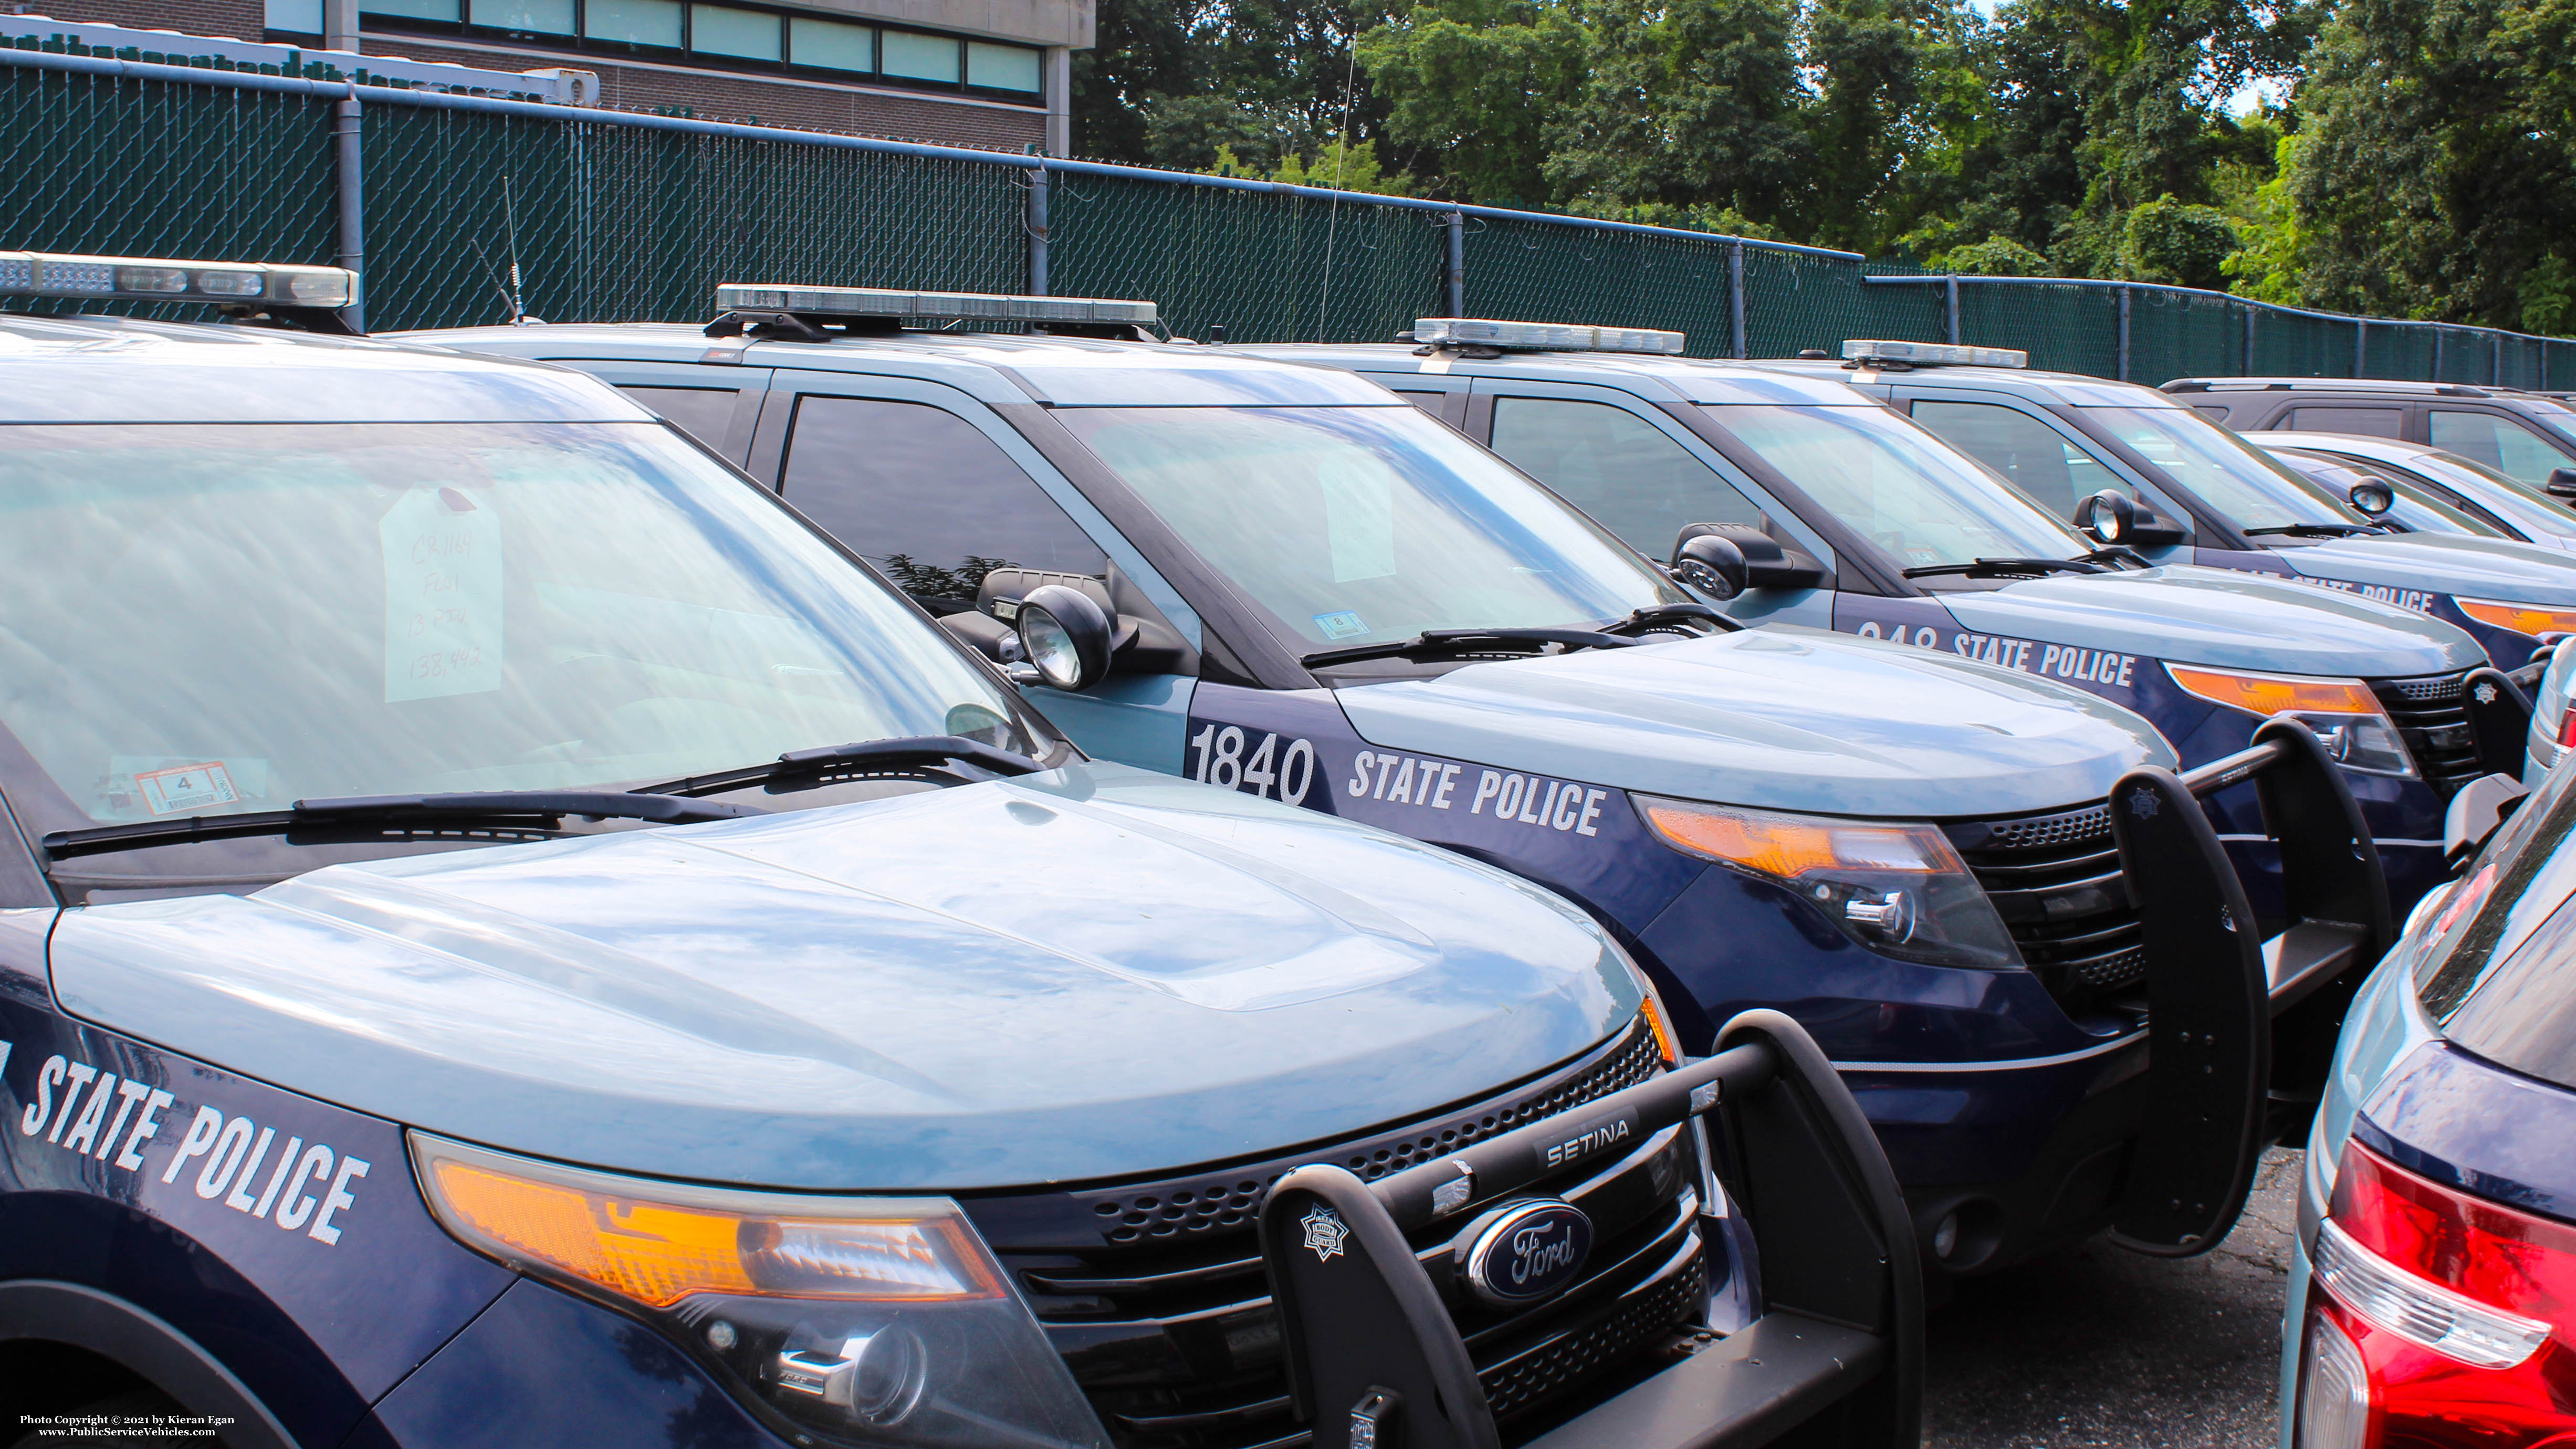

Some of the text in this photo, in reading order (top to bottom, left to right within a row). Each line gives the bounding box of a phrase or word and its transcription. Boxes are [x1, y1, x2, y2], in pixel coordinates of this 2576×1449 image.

[1953, 633, 2033, 671] STATE
[2039, 644, 2138, 688] POLICE
[178, 776, 193, 789] 4
[1191, 723, 1608, 837] 1840 STATE POLICE
[21, 1054, 372, 1246] STATE POLICE
[1546, 1118, 1630, 1168] SETINA
[1314, 1237, 1334, 1245] GUARD
[1511, 1220, 1576, 1285] Ford
